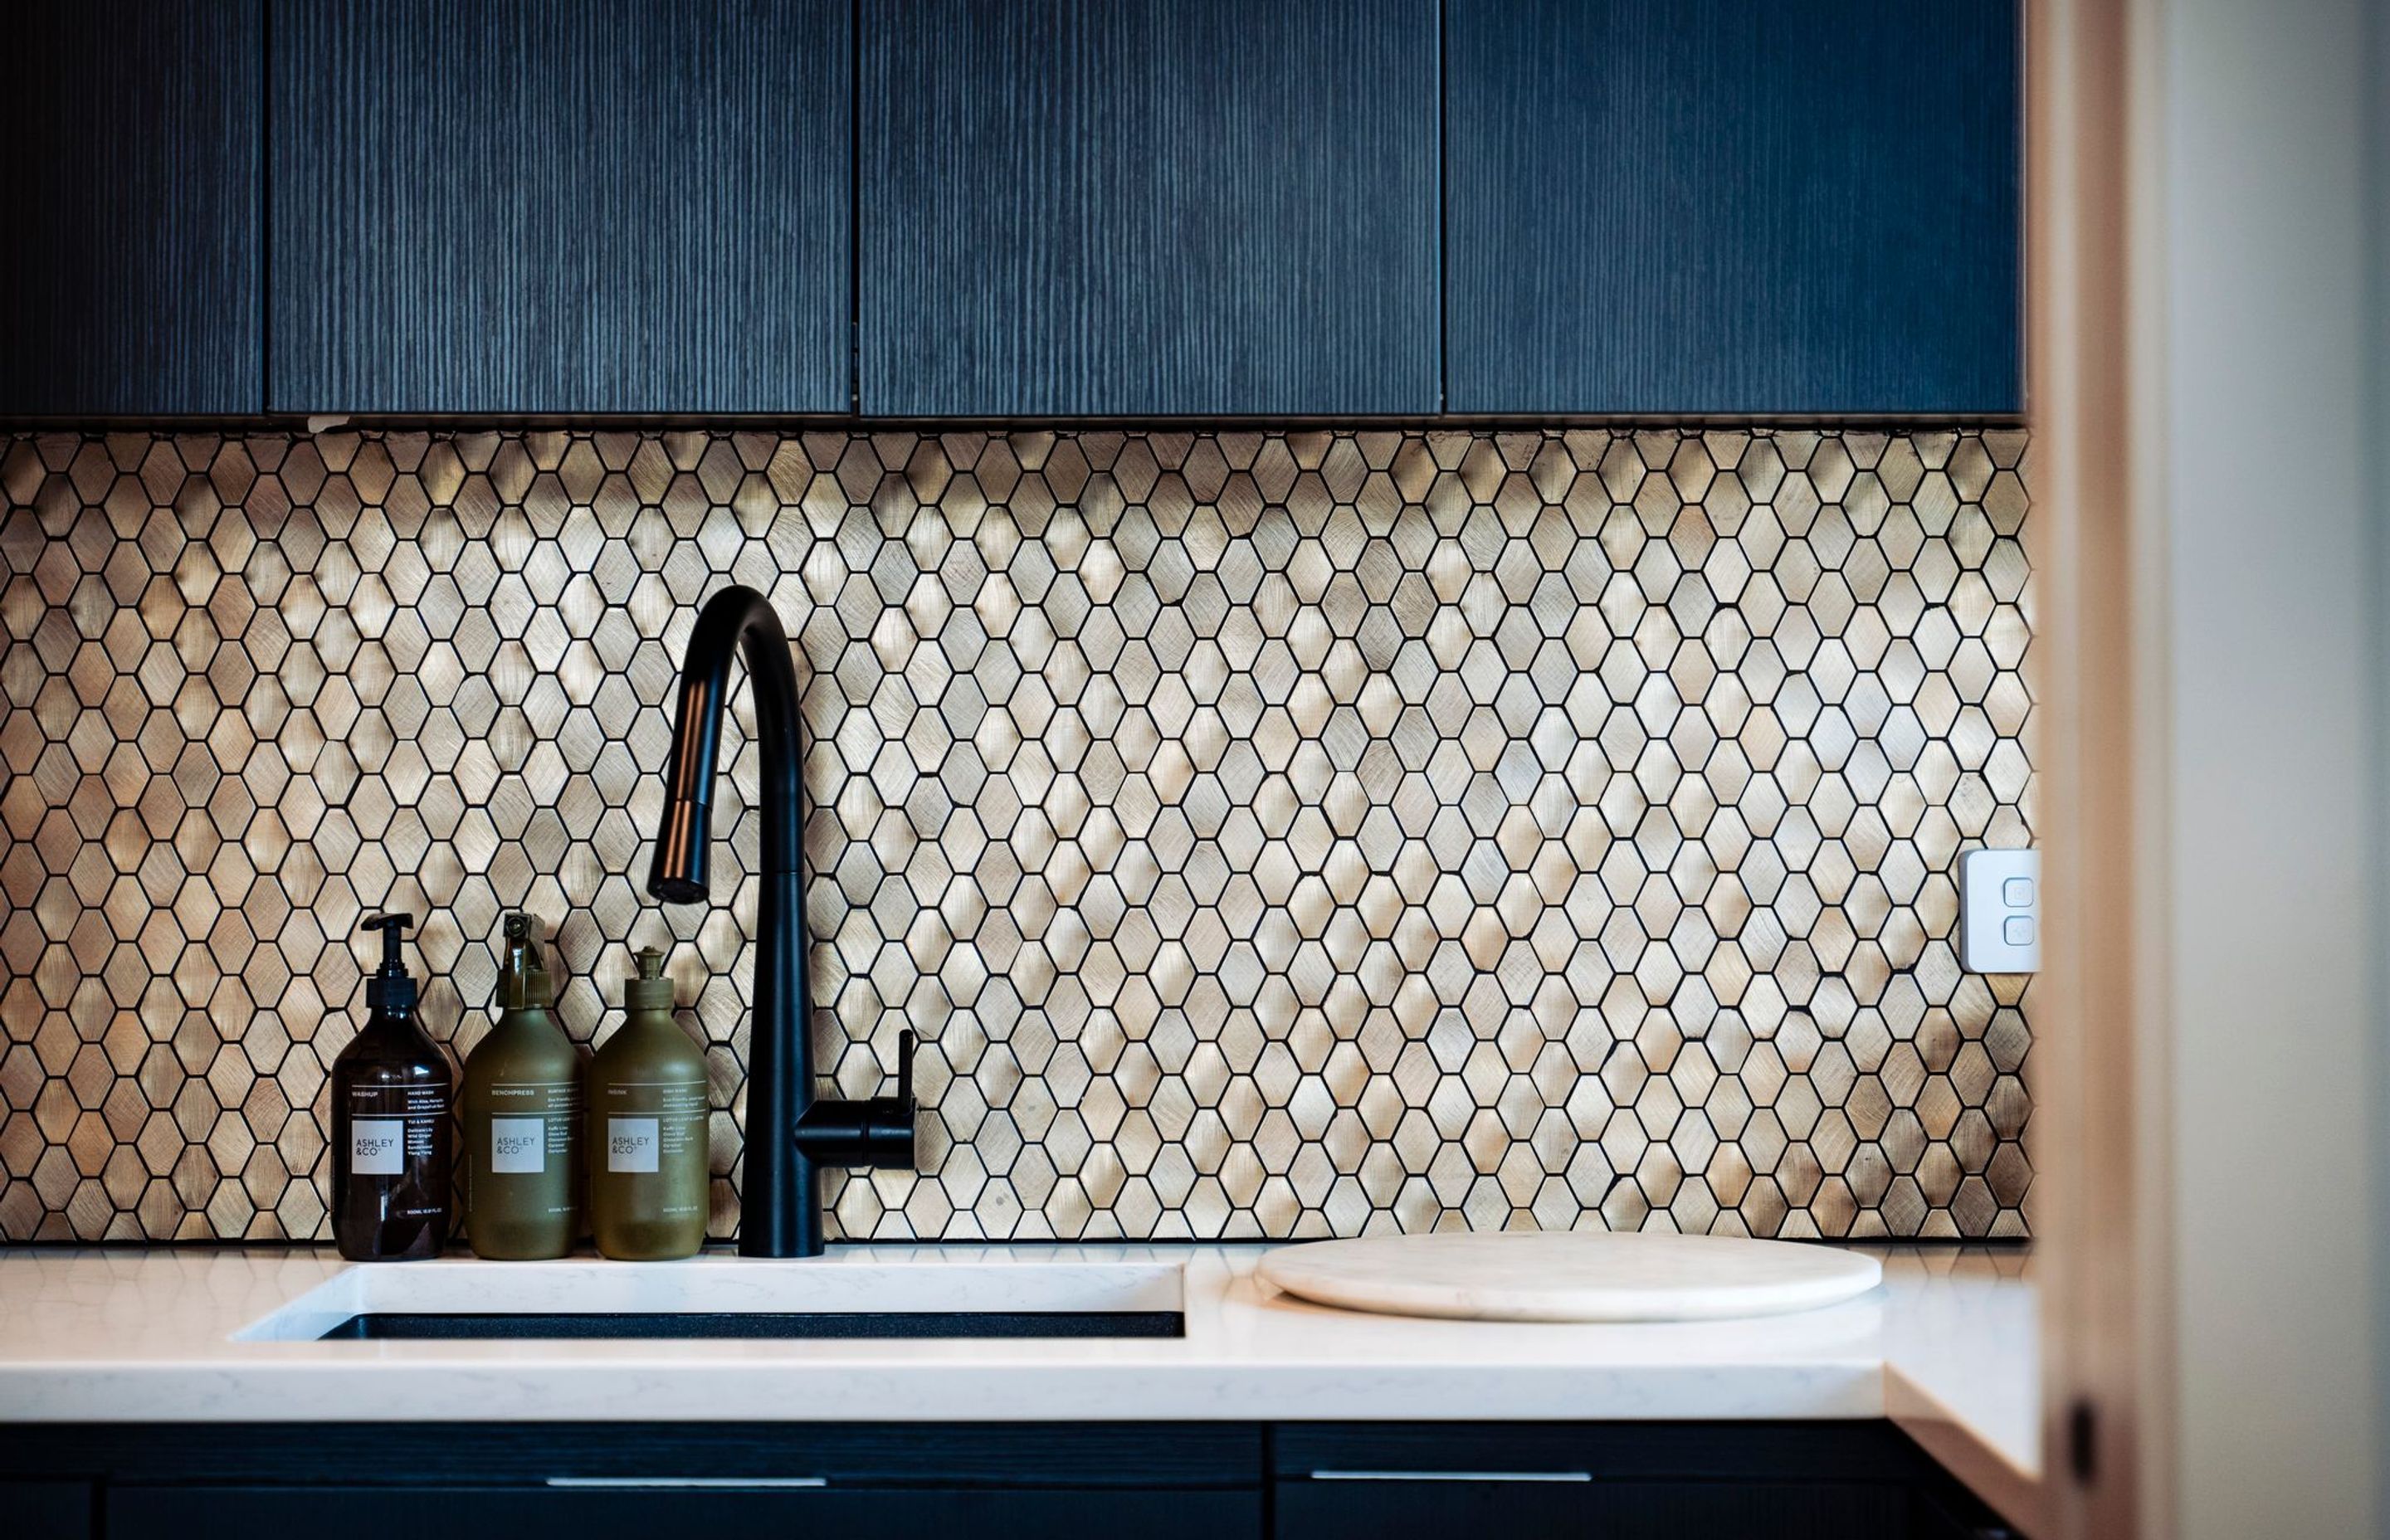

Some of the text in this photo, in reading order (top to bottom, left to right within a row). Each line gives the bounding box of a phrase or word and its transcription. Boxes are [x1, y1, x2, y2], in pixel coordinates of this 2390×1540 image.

[356, 1138, 394, 1148] ASHLEY
[496, 1137, 534, 1146] ASHLEY
[612, 1137, 650, 1146] ASHLEY
